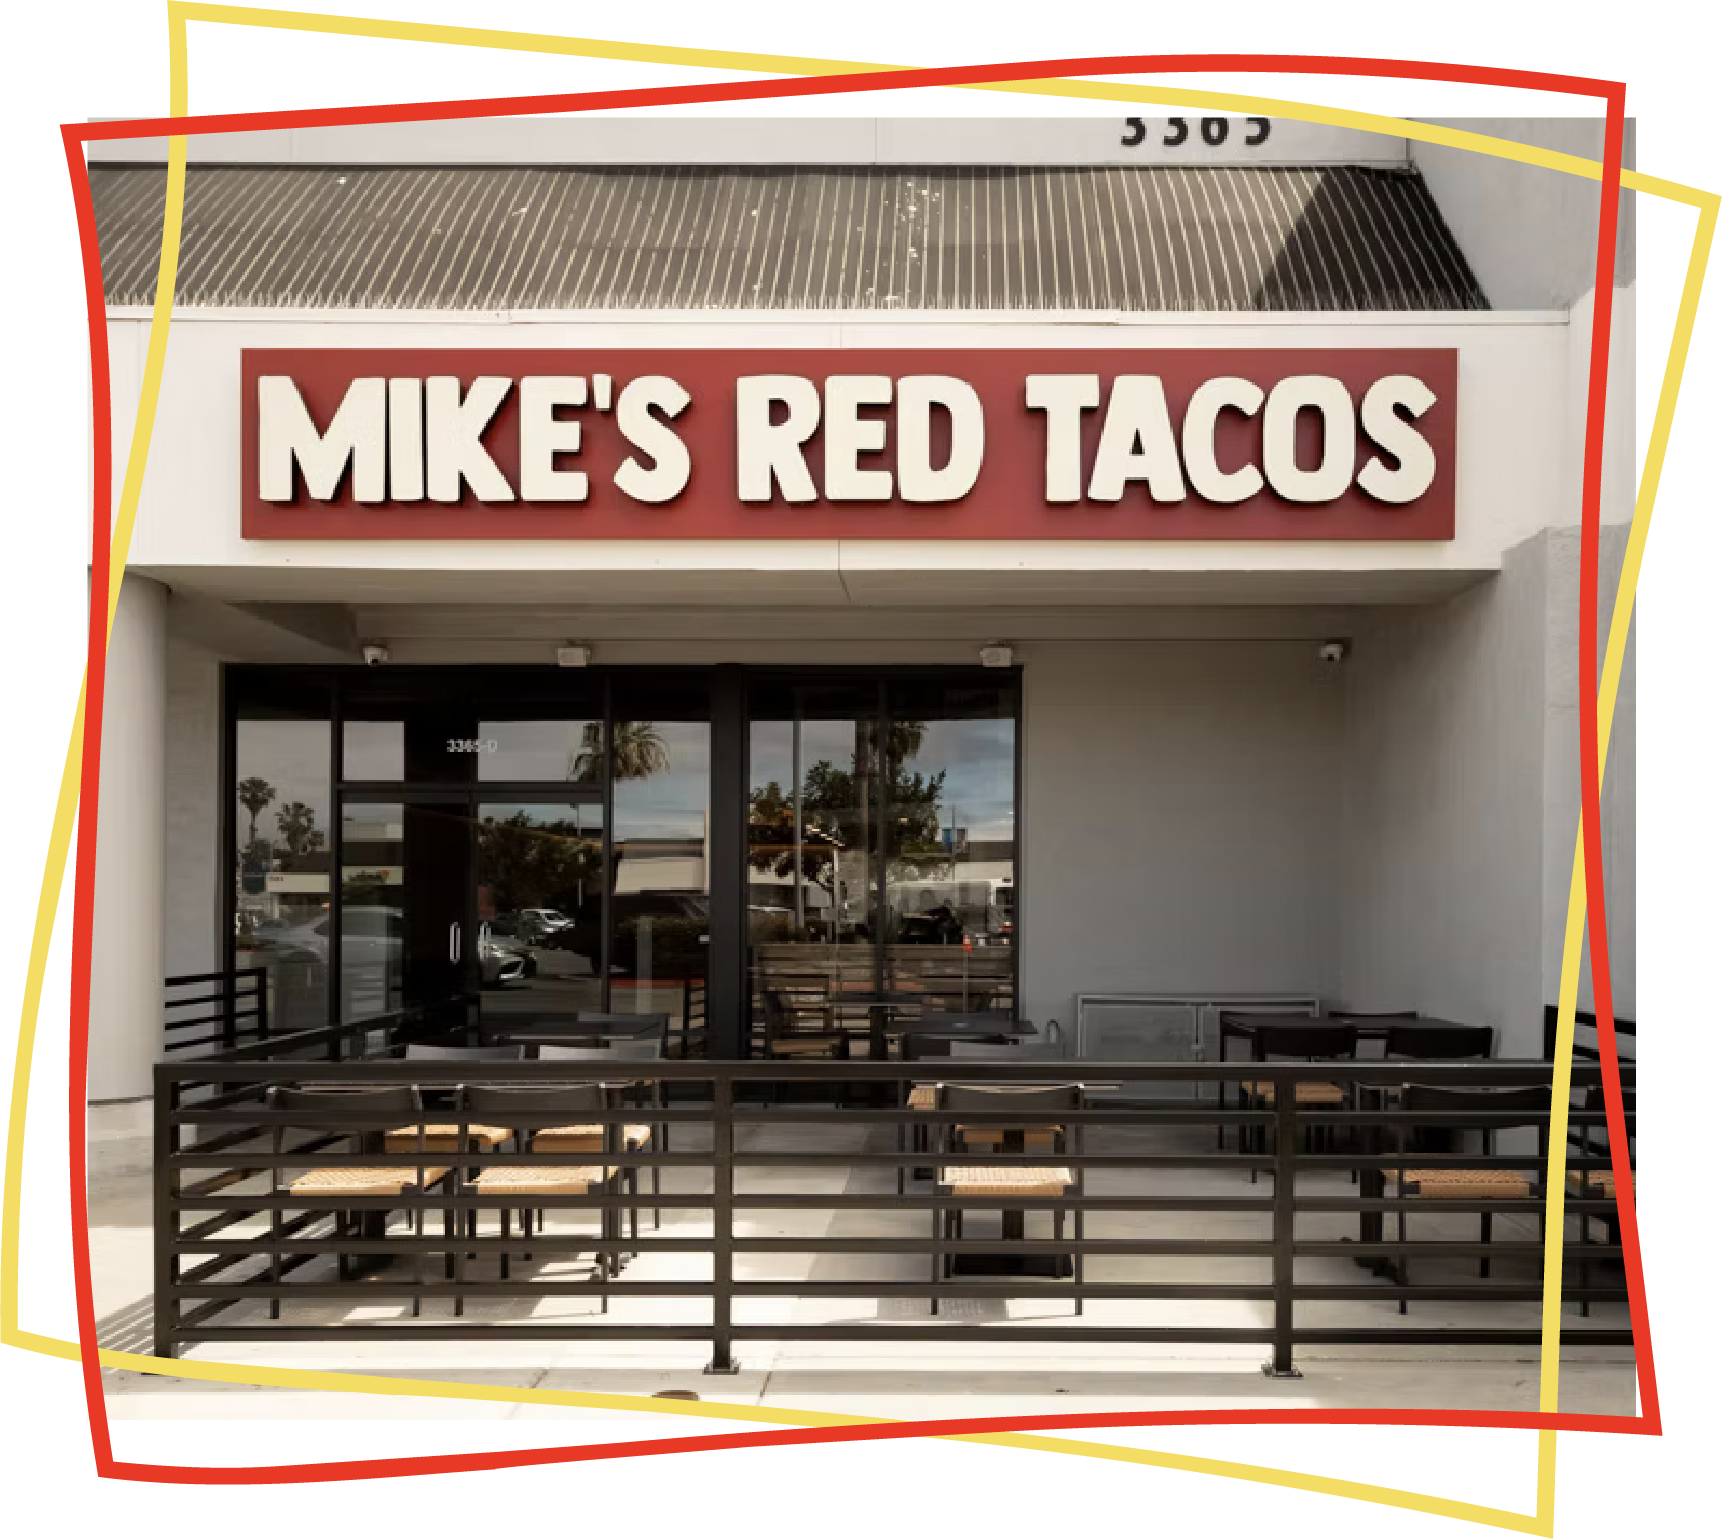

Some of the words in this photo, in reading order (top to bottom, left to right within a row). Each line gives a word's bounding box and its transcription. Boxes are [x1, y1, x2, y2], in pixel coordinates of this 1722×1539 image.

[258, 373, 692, 503] MIKE'S
[736, 374, 985, 503] RED
[1025, 374, 1438, 503] TACOS
